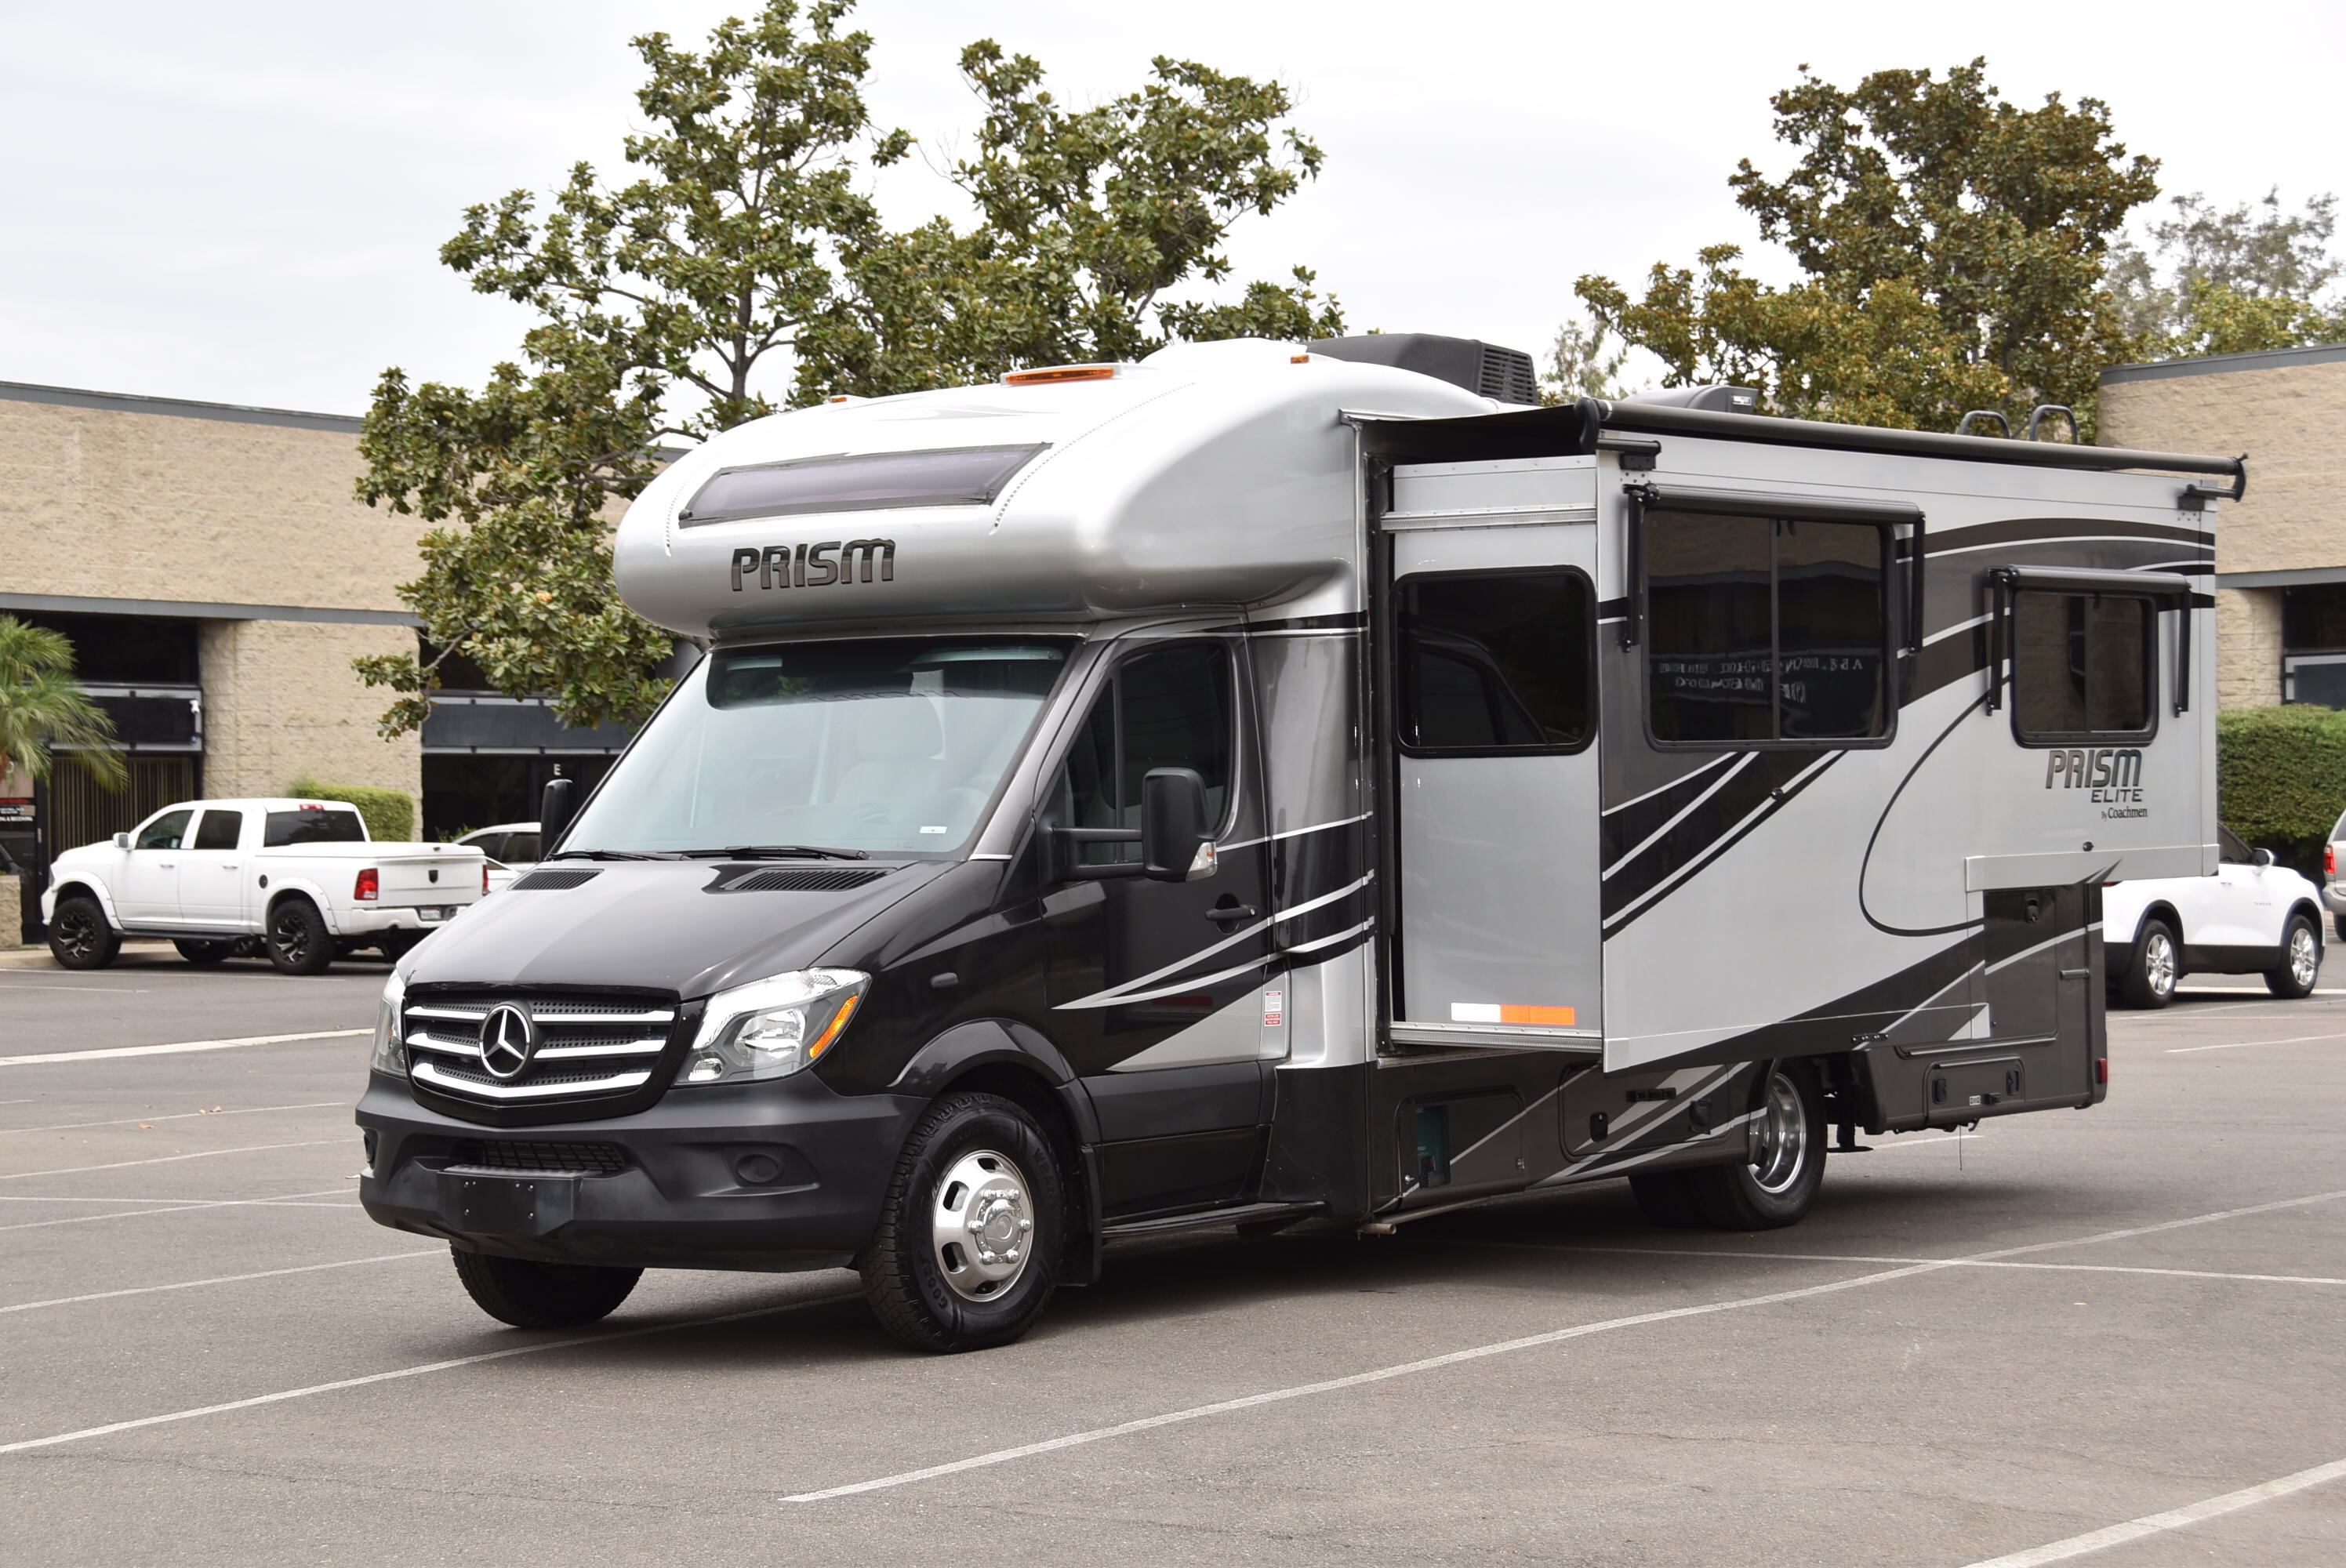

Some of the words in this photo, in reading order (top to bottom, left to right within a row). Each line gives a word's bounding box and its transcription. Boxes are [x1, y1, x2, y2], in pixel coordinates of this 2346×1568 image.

[732, 538, 895, 592] PRISM
[553, 764, 561, 776] E
[2046, 749, 2142, 789] PRISM
[2091, 789, 2143, 803] ELITE
[2108, 806, 2148, 819] Coachmen
